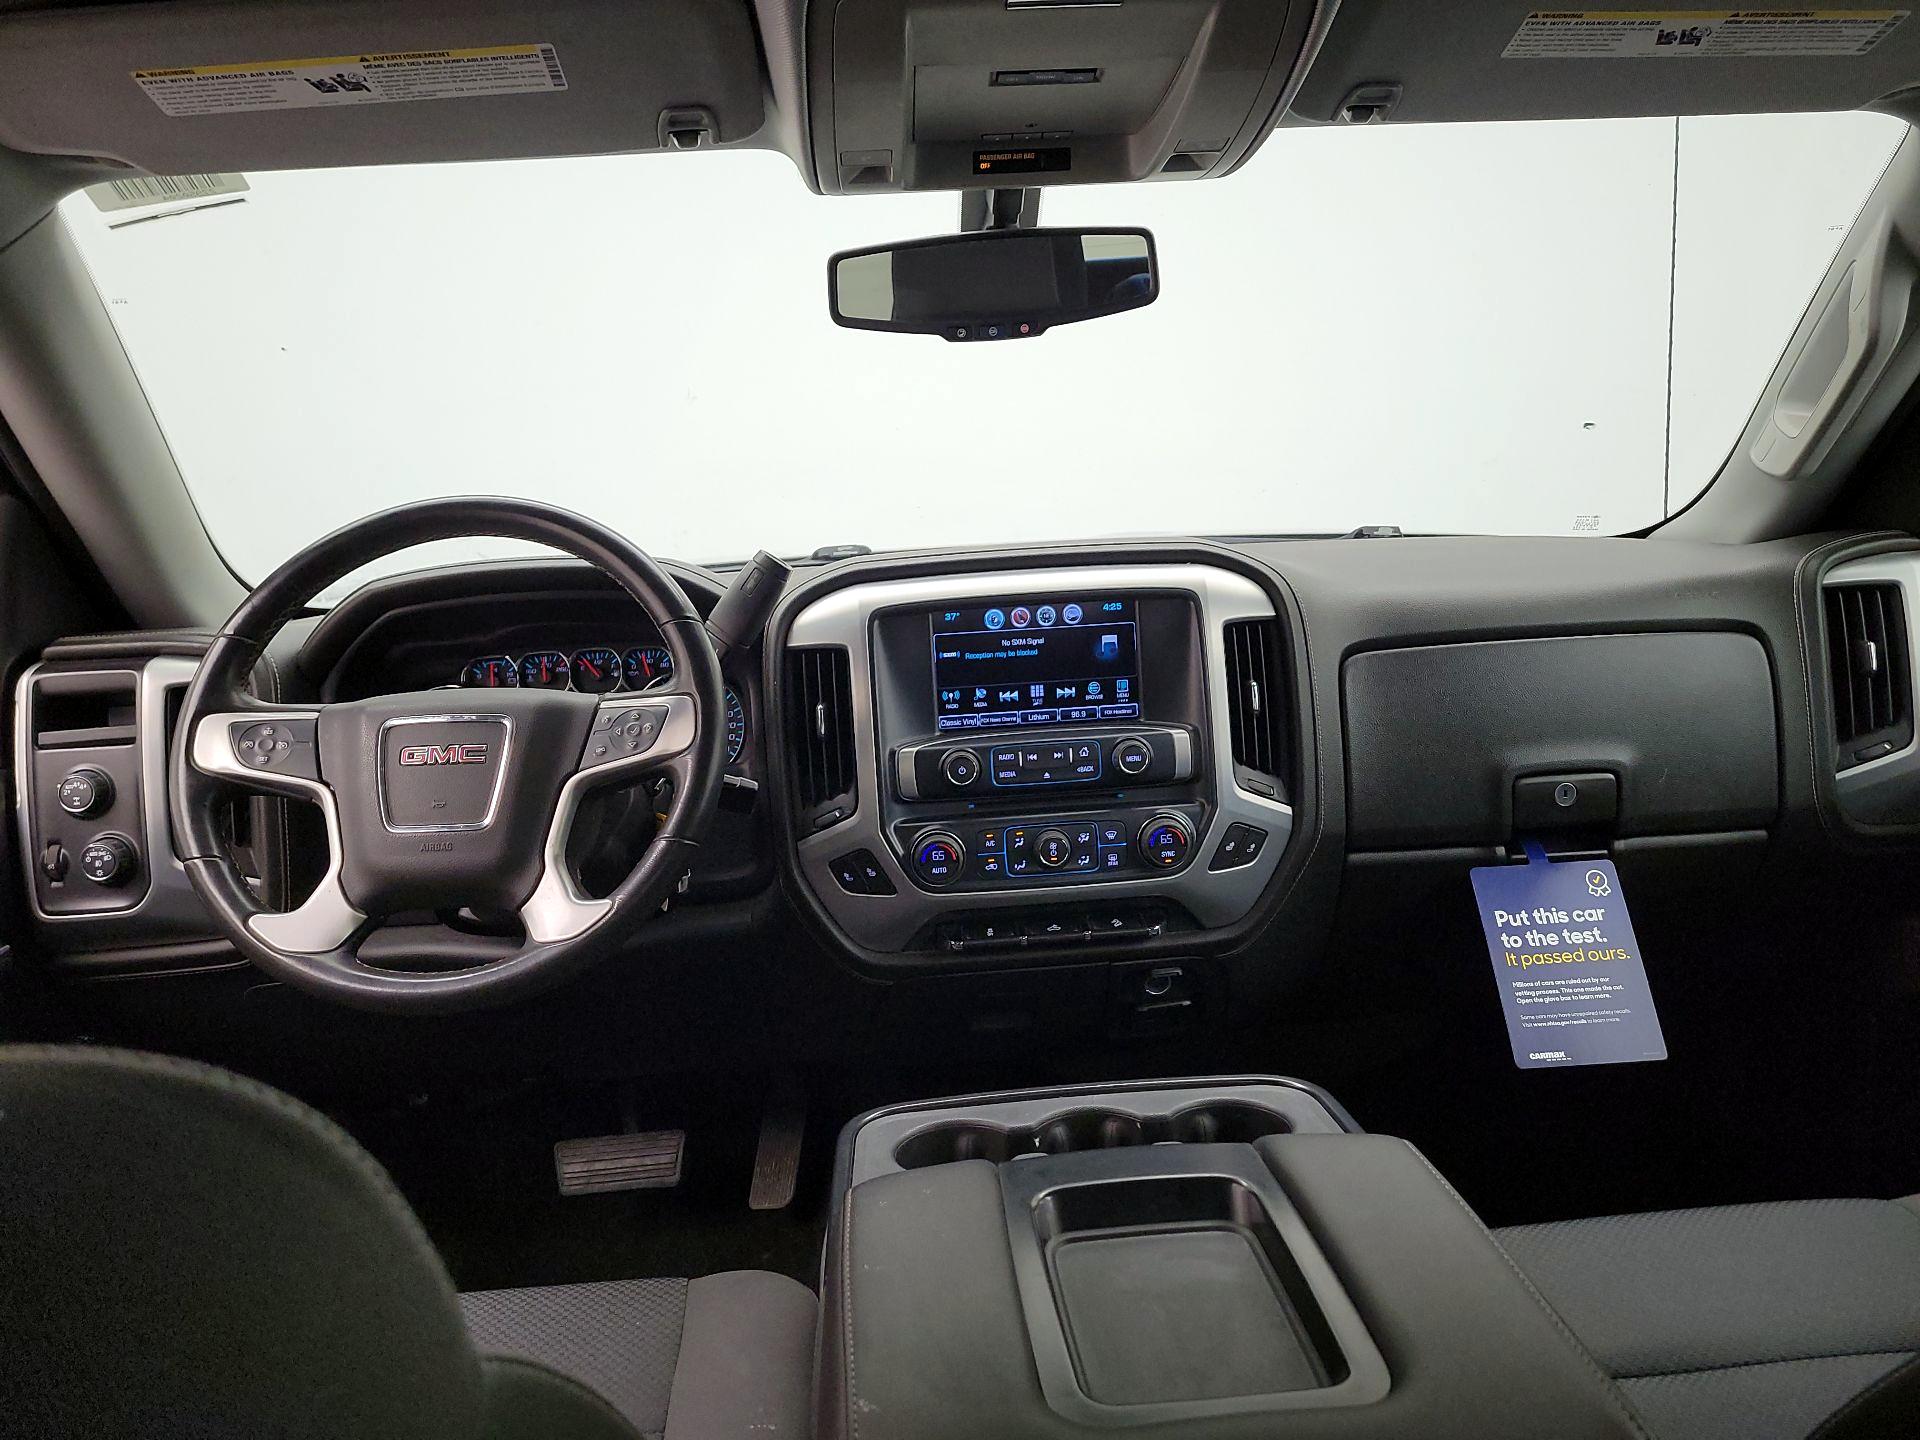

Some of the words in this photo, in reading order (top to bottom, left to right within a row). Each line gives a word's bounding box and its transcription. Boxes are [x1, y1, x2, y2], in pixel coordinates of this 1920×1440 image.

[373, 51, 450, 62] AVERTISSEMENT
[980, 162, 991, 170] OFF
[1102, 602, 1122, 612] 4:25
[1011, 638, 1026, 646] SXM
[1026, 637, 1044, 646] Signal
[965, 652, 994, 660] Reception
[1016, 648, 1038, 656] blocked
[1028, 712, 1050, 720] Lithium
[940, 719, 962, 727] Classic
[962, 717, 977, 726] Vinyl
[400, 744, 488, 766] GMC
[998, 752, 1015, 762] RADIO
[1126, 754, 1142, 763] MENU
[1079, 764, 1094, 773] BACK
[999, 770, 1016, 778] MEDIA
[985, 840, 996, 848] A/C
[1160, 834, 1172, 844] 65
[421, 842, 454, 852] AIRBAG
[932, 850, 945, 861] 65
[1161, 850, 1176, 858] SYNC
[932, 866, 948, 874] AUTO
[1494, 909, 1531, 928] Put
[1532, 907, 1570, 925] this
[1572, 907, 1606, 923] car
[1500, 931, 1522, 949] to
[1525, 929, 1560, 947] the
[1562, 926, 1608, 945] test.
[1504, 951, 1519, 968] It
[1520, 947, 1585, 970] passed
[1588, 948, 1632, 962] ours.
[1566, 977, 1582, 985] ruled
[1591, 976, 1599, 984] by
[1514, 989, 1536, 998] vetting
[1536, 988, 1560, 996] process.
[1602, 984, 1612, 992] the
[1516, 997, 1534, 1006] Open
[1534, 996, 1544, 1004] the
[1544, 996, 1560, 1004] glove
[1594, 992, 1612, 1000] more.
